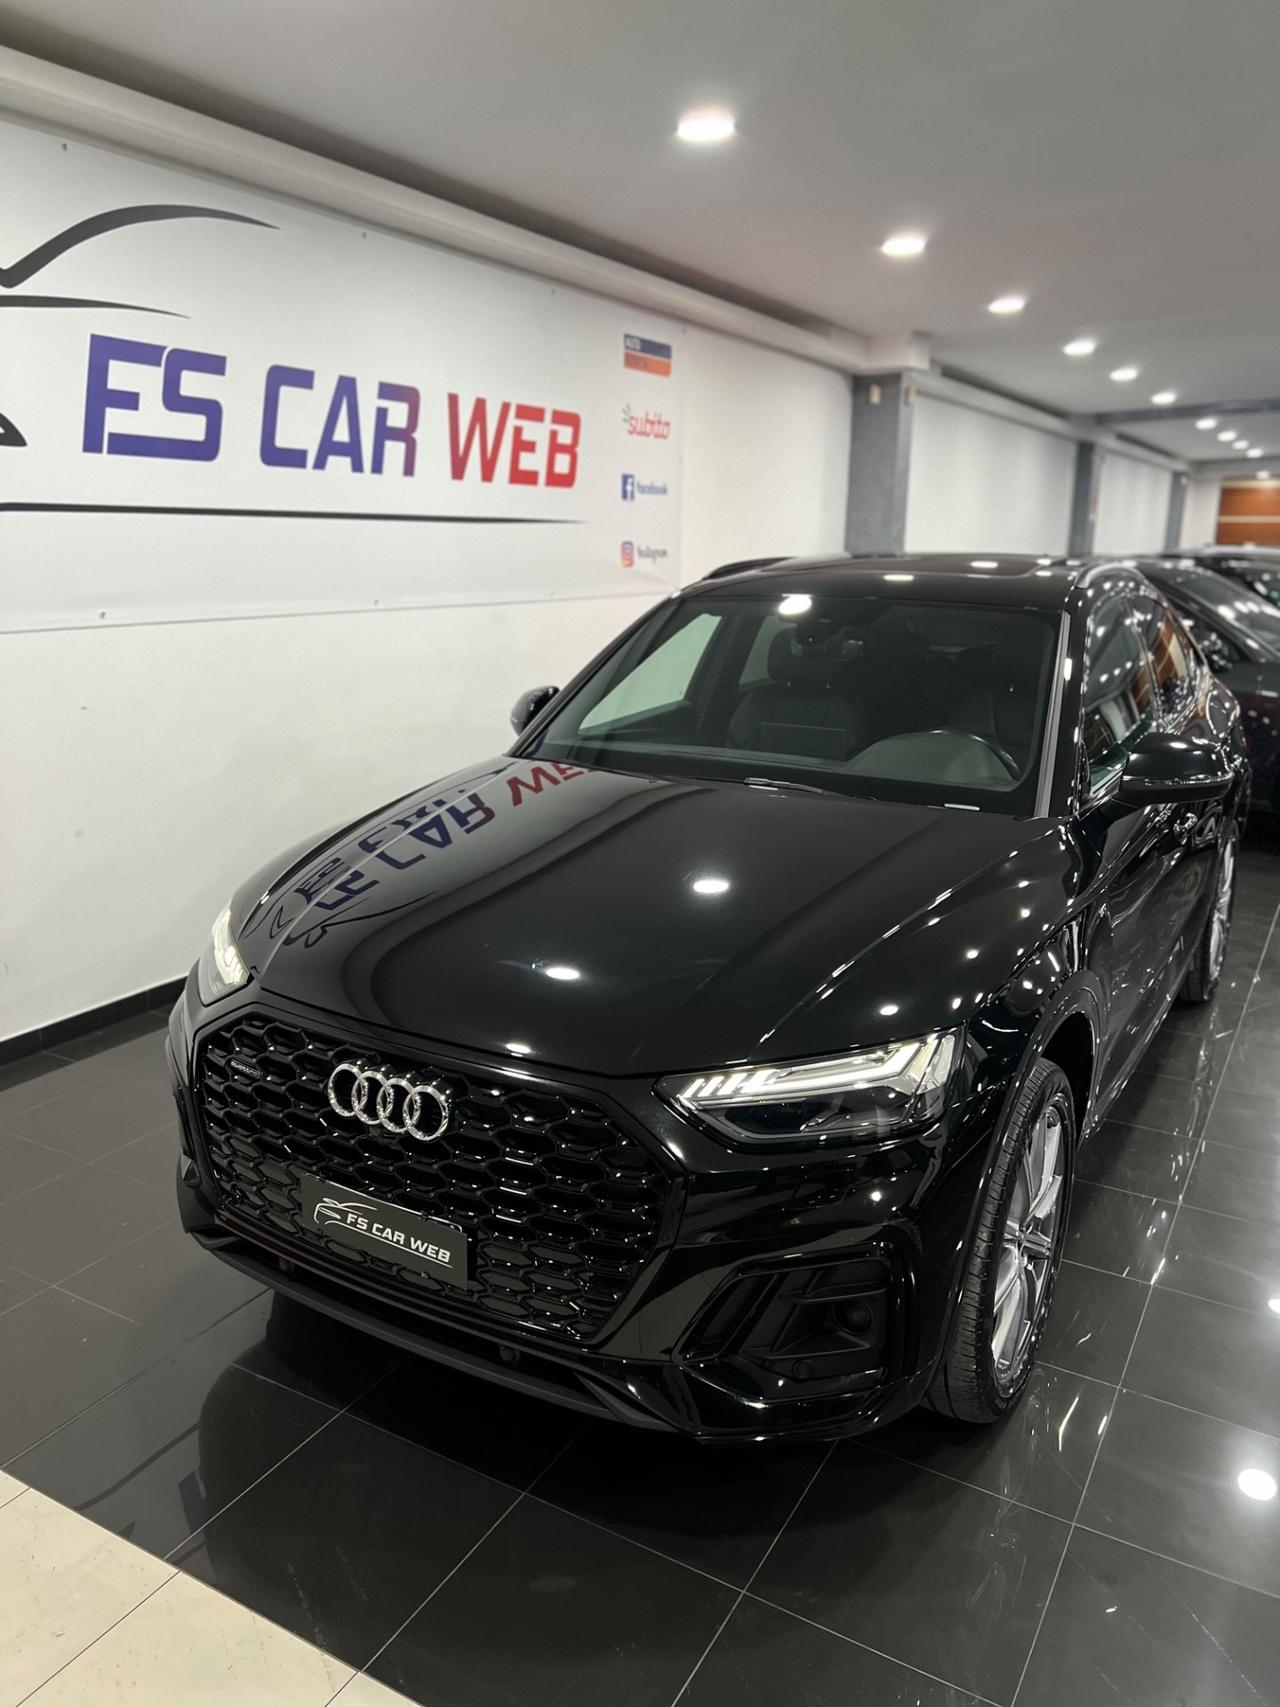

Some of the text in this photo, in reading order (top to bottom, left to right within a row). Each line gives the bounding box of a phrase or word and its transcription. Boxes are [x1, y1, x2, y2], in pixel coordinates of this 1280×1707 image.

[259, 364, 420, 477] CAR
[447, 392, 581, 489] WEB
[627, 410, 671, 440] subito
[347, 1213, 451, 1263] FS CAR WEB
